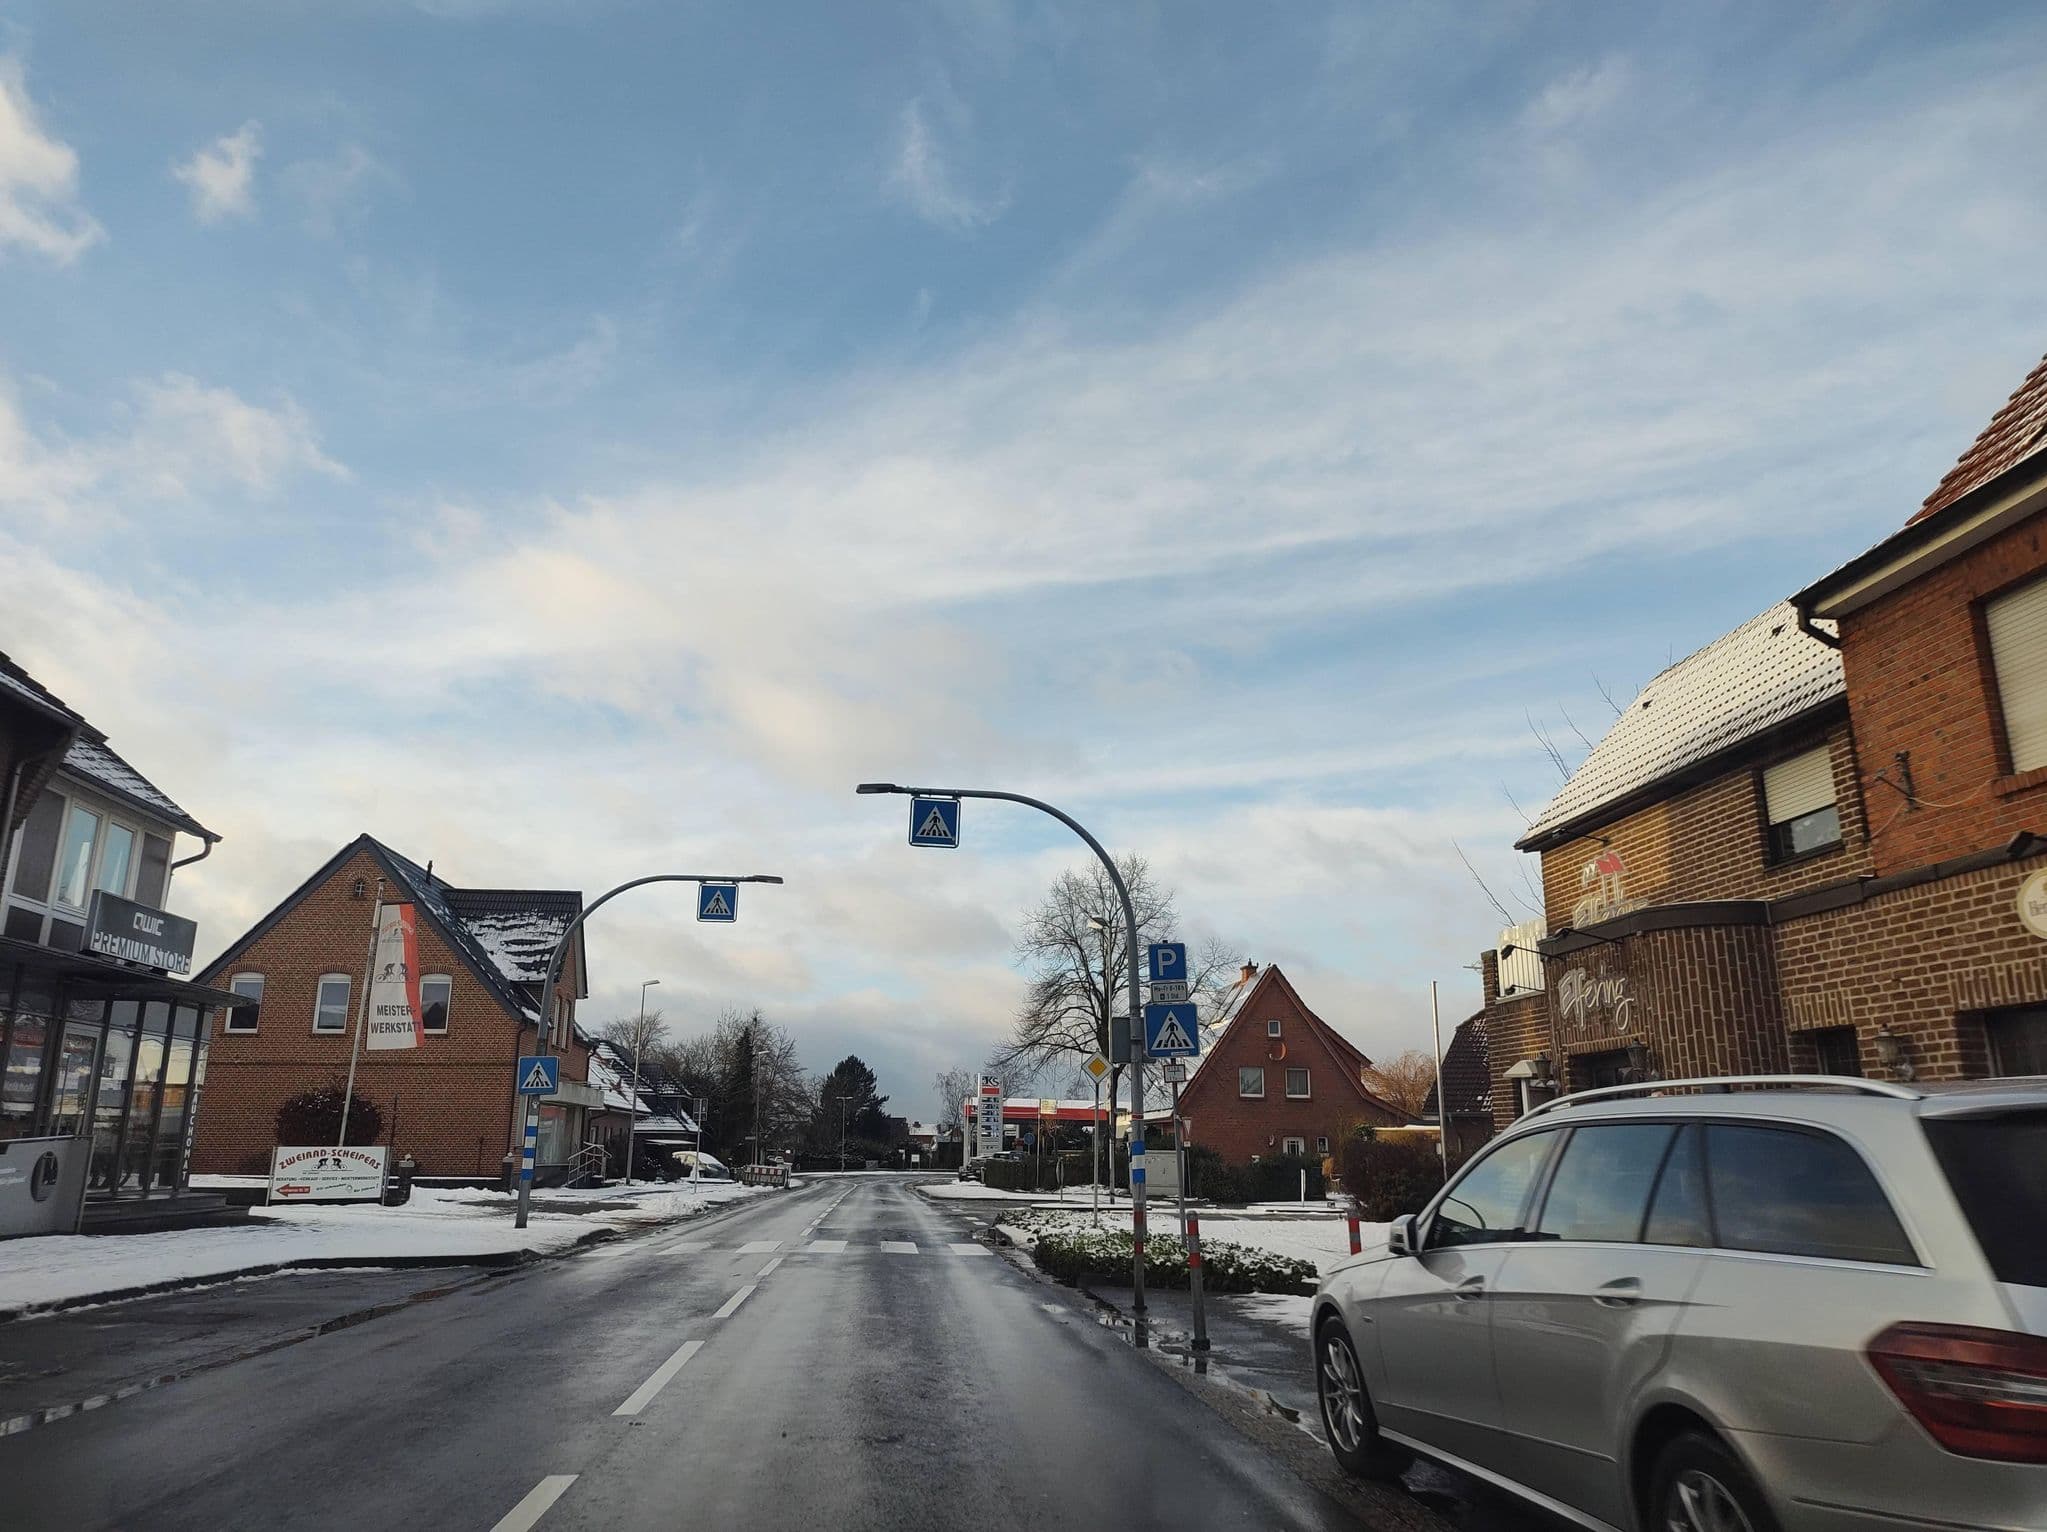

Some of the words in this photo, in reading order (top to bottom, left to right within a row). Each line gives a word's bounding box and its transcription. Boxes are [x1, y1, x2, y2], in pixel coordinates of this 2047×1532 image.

[92, 931, 151, 963] PREMIUM
[153, 948, 192, 973] STORE
[1157, 949, 1177, 977] P
[376, 1004, 416, 1017] MEISTER-
[1558, 966, 1635, 1031] Elfering
